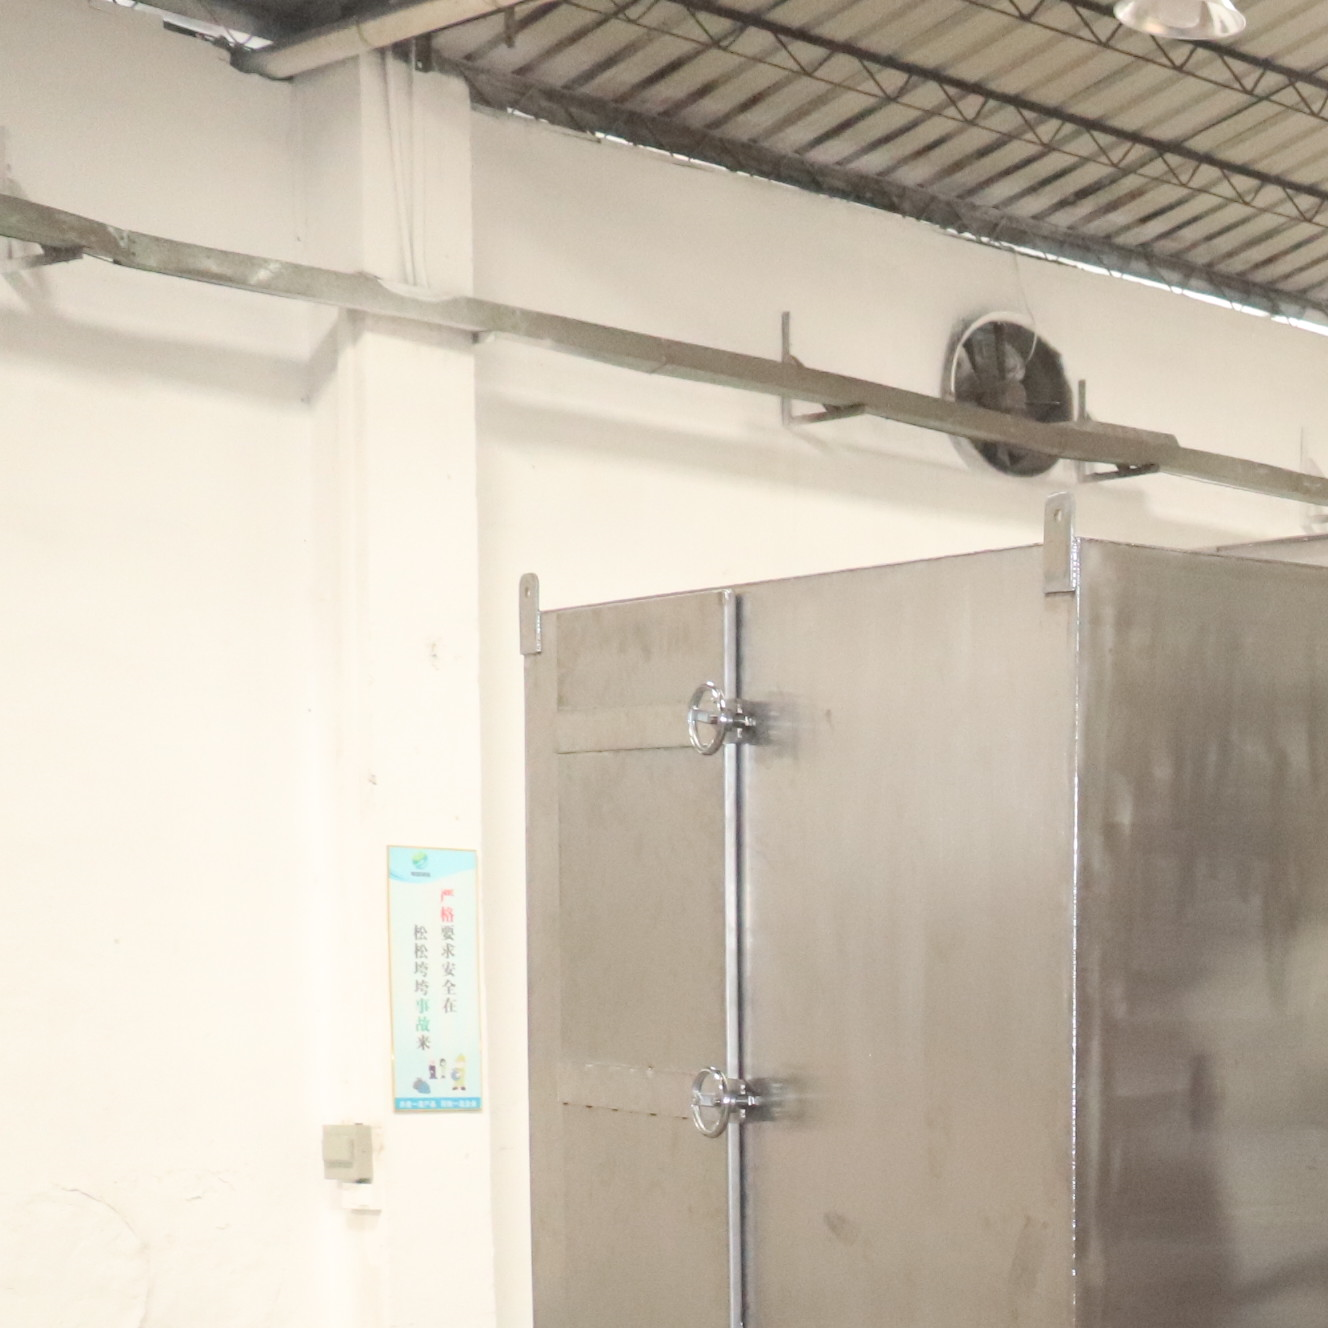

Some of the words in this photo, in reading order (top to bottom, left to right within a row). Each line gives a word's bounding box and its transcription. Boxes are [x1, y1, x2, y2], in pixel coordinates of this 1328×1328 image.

[413, 924, 431, 1051] 松松垮垮事故来
[440, 888, 457, 1014] 严格要求安全在
